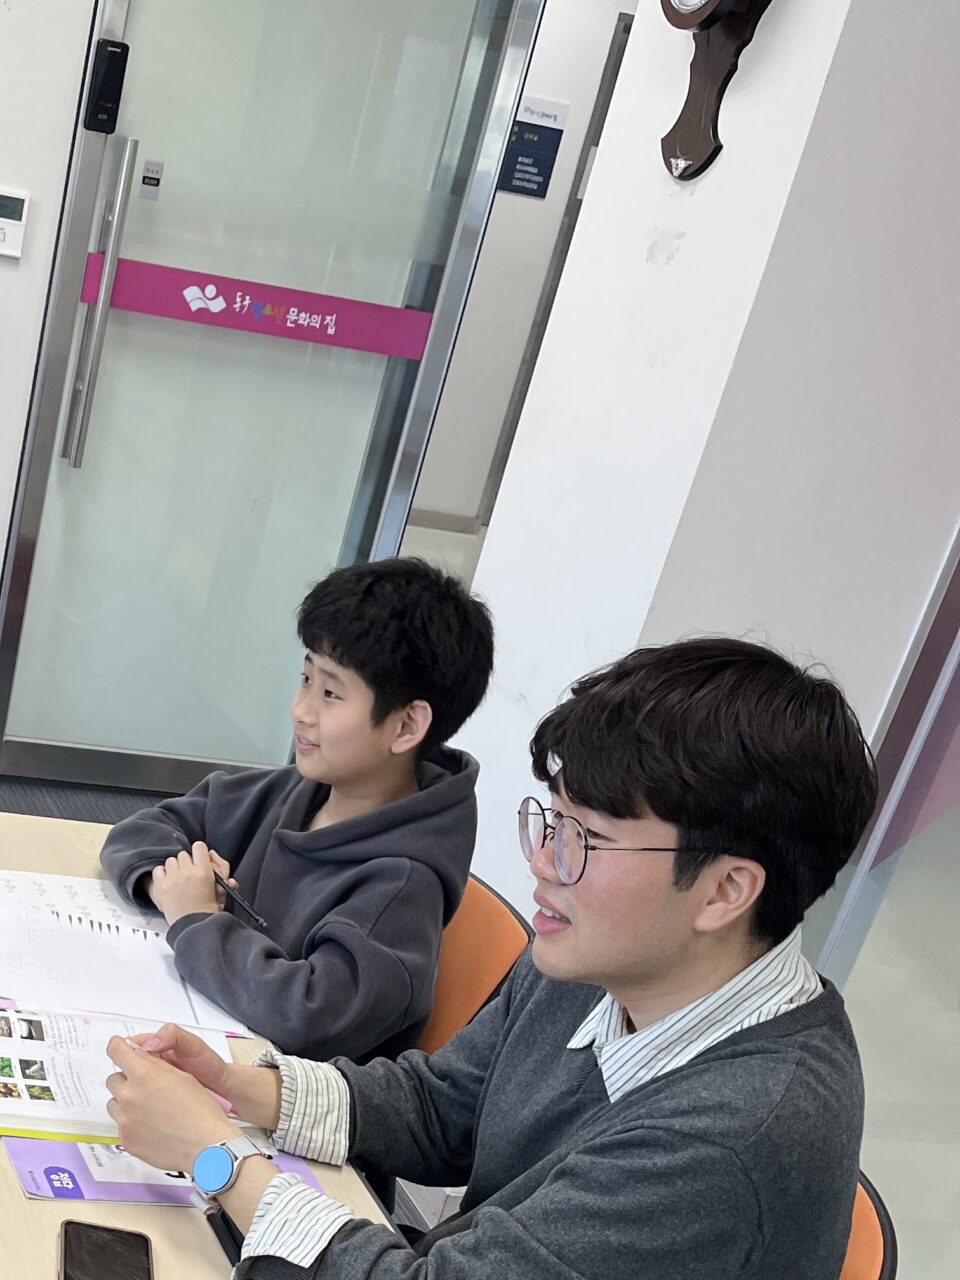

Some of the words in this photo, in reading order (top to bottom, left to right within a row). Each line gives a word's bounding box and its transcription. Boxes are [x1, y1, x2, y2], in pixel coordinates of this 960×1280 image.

[286, 307, 321, 329] 문화의
[324, 314, 337, 335] 집
[50, 1171, 75, 1190] 정답
